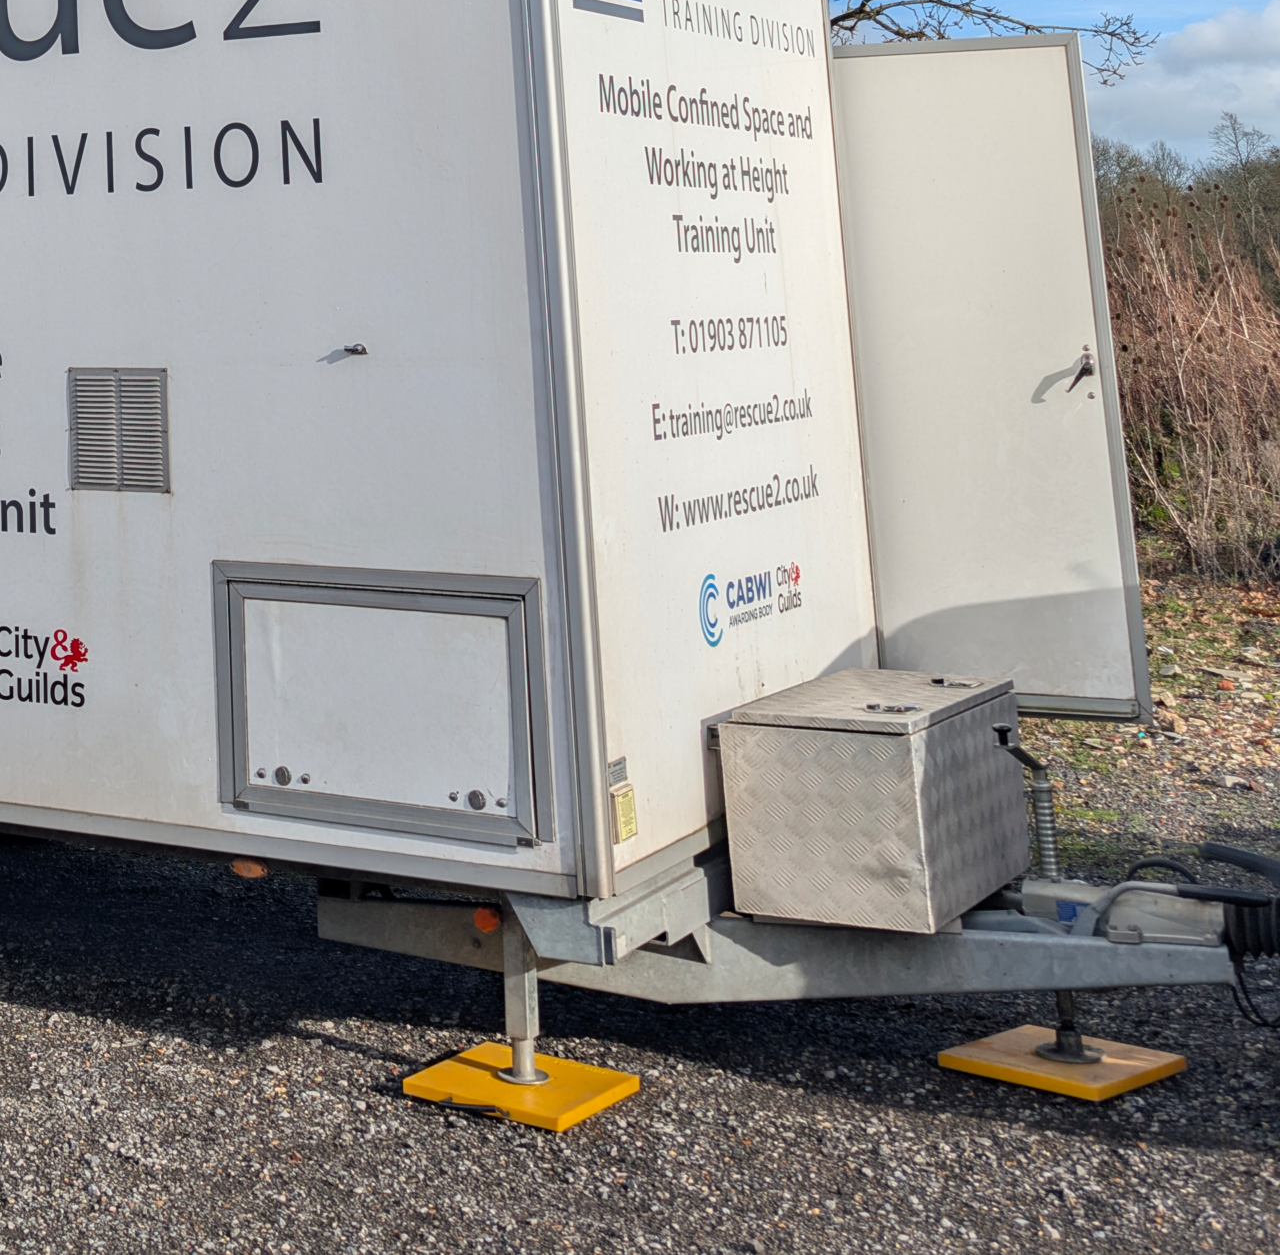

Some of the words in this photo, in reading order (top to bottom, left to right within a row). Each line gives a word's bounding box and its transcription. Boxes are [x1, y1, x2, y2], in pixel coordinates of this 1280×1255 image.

[750, 15, 814, 57] DIVISION
[599, 74, 662, 120] Mobile
[667, 85, 739, 129] Confined
[743, 97, 784, 141] Space
[788, 106, 812, 139] and
[645, 147, 718, 199] Working
[722, 159, 737, 191] at
[740, 156, 788, 203] Height
[673, 215, 741, 263] Training
[744, 218, 776, 253] Unit
[671, 320, 685, 354] T:
[689, 318, 734, 353] 01903
[738, 316, 787, 349] 871105
[652, 403, 666, 440] E:
[669, 389, 812, 440] training@rescue2.co.uk
[658, 495, 679, 532] W:
[683, 465, 819, 527] www.rescue2.co.uk
[726, 570, 772, 610] CABWI
[778, 588, 802, 614] Guilds
[729, 608, 758, 628] AWARDING
[759, 604, 773, 619] BODY
